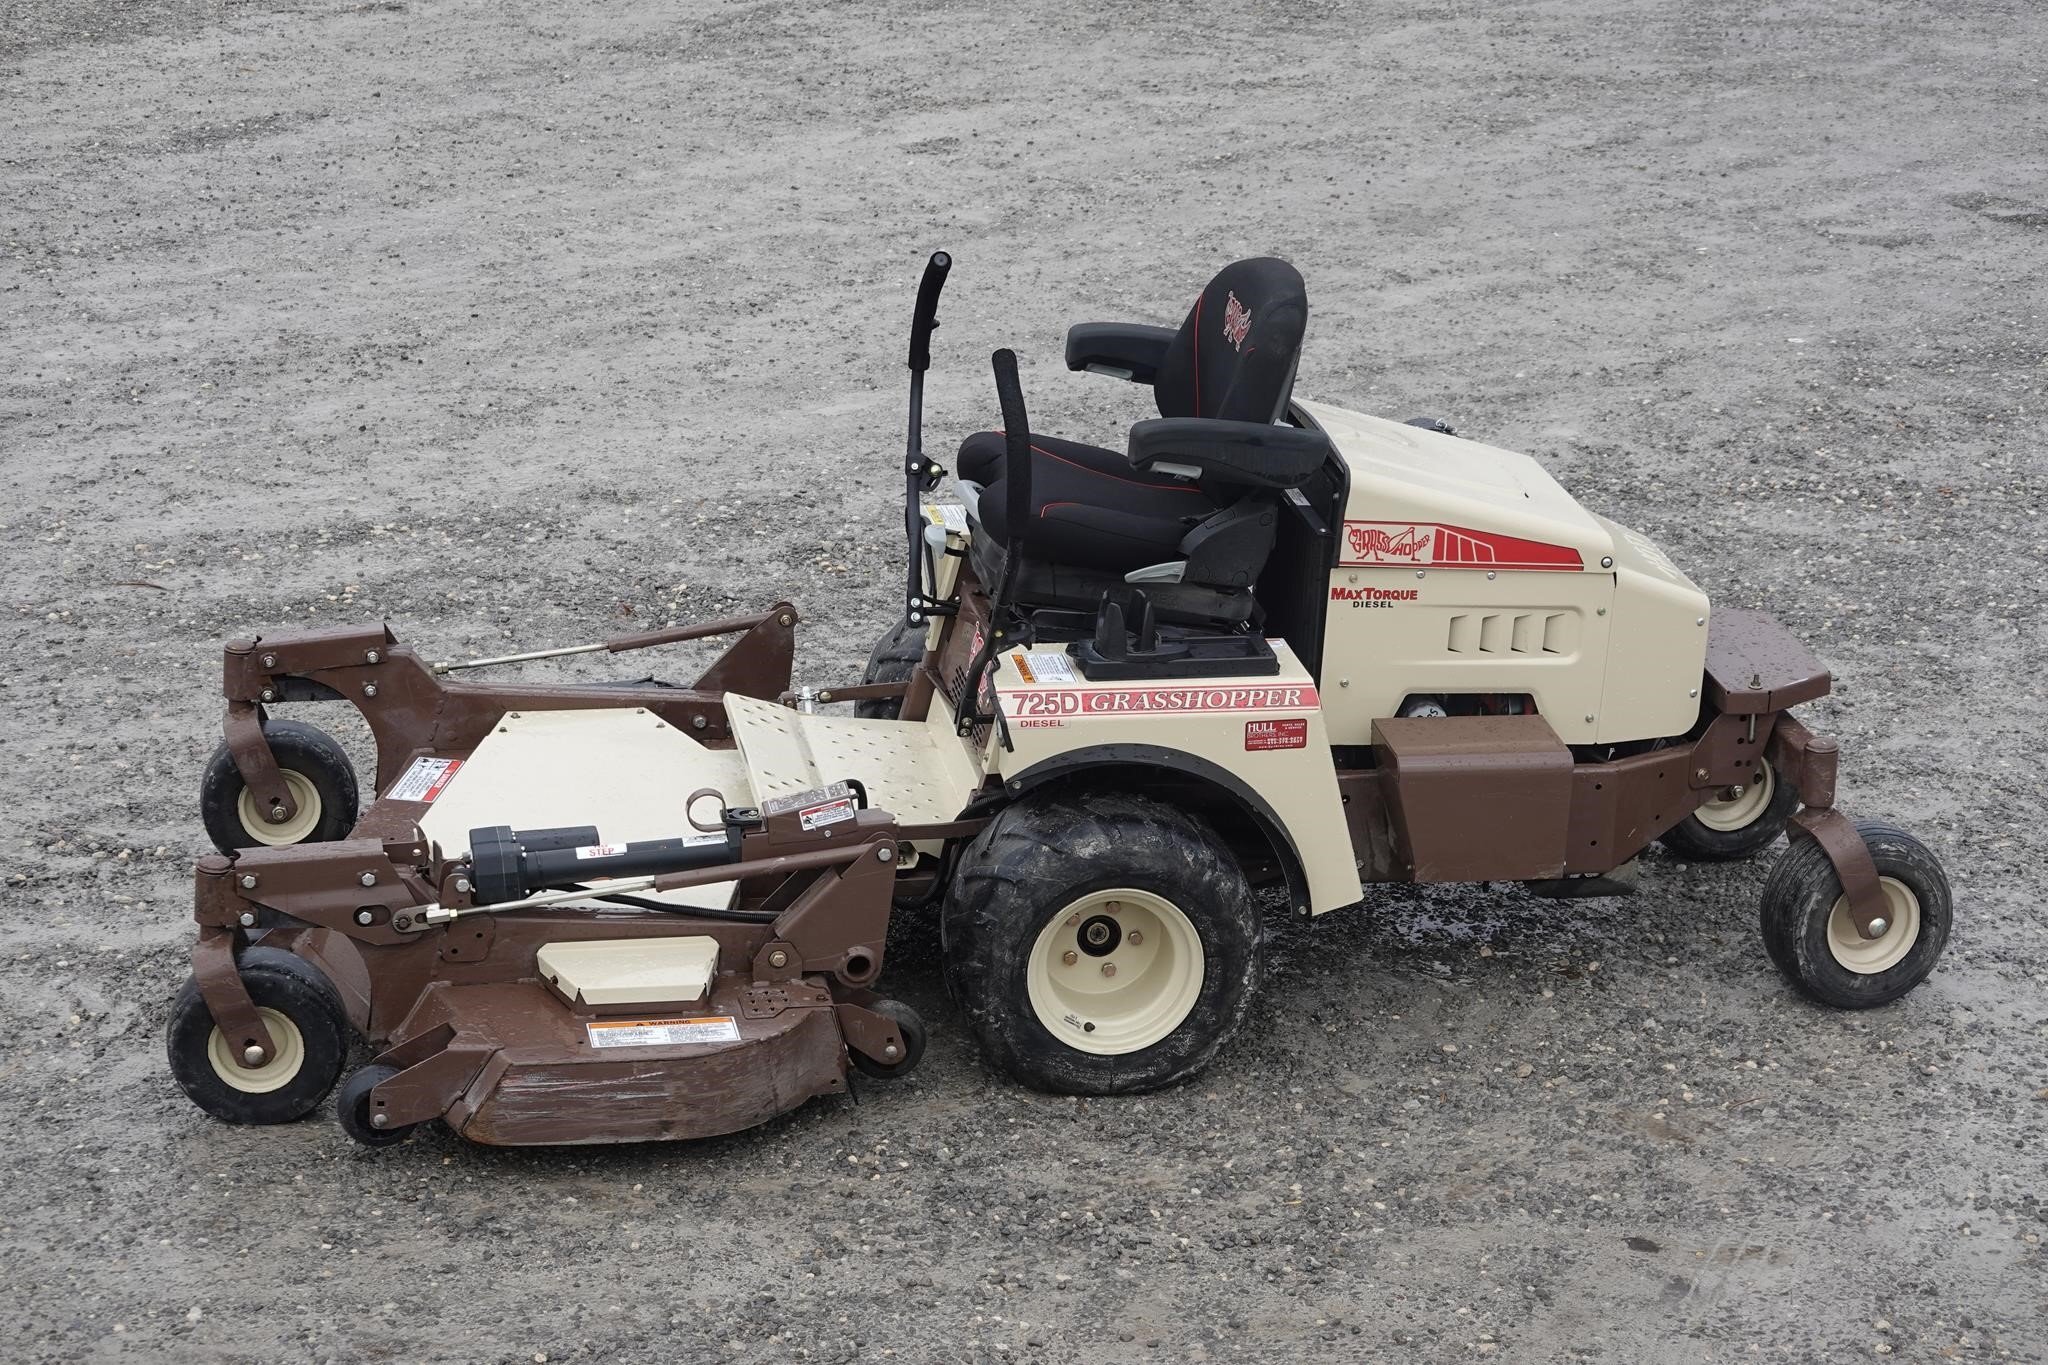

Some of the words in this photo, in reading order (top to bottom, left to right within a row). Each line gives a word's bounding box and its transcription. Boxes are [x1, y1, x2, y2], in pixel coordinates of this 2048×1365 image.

[1352, 601, 1394, 609] DIESEL
[1012, 693, 1080, 715] 725D
[1090, 689, 1301, 711] GRASSHOPPER
[1020, 720, 1064, 728] DIESEL
[1248, 722, 1276, 732] HULL
[589, 848, 614, 857] STEP
